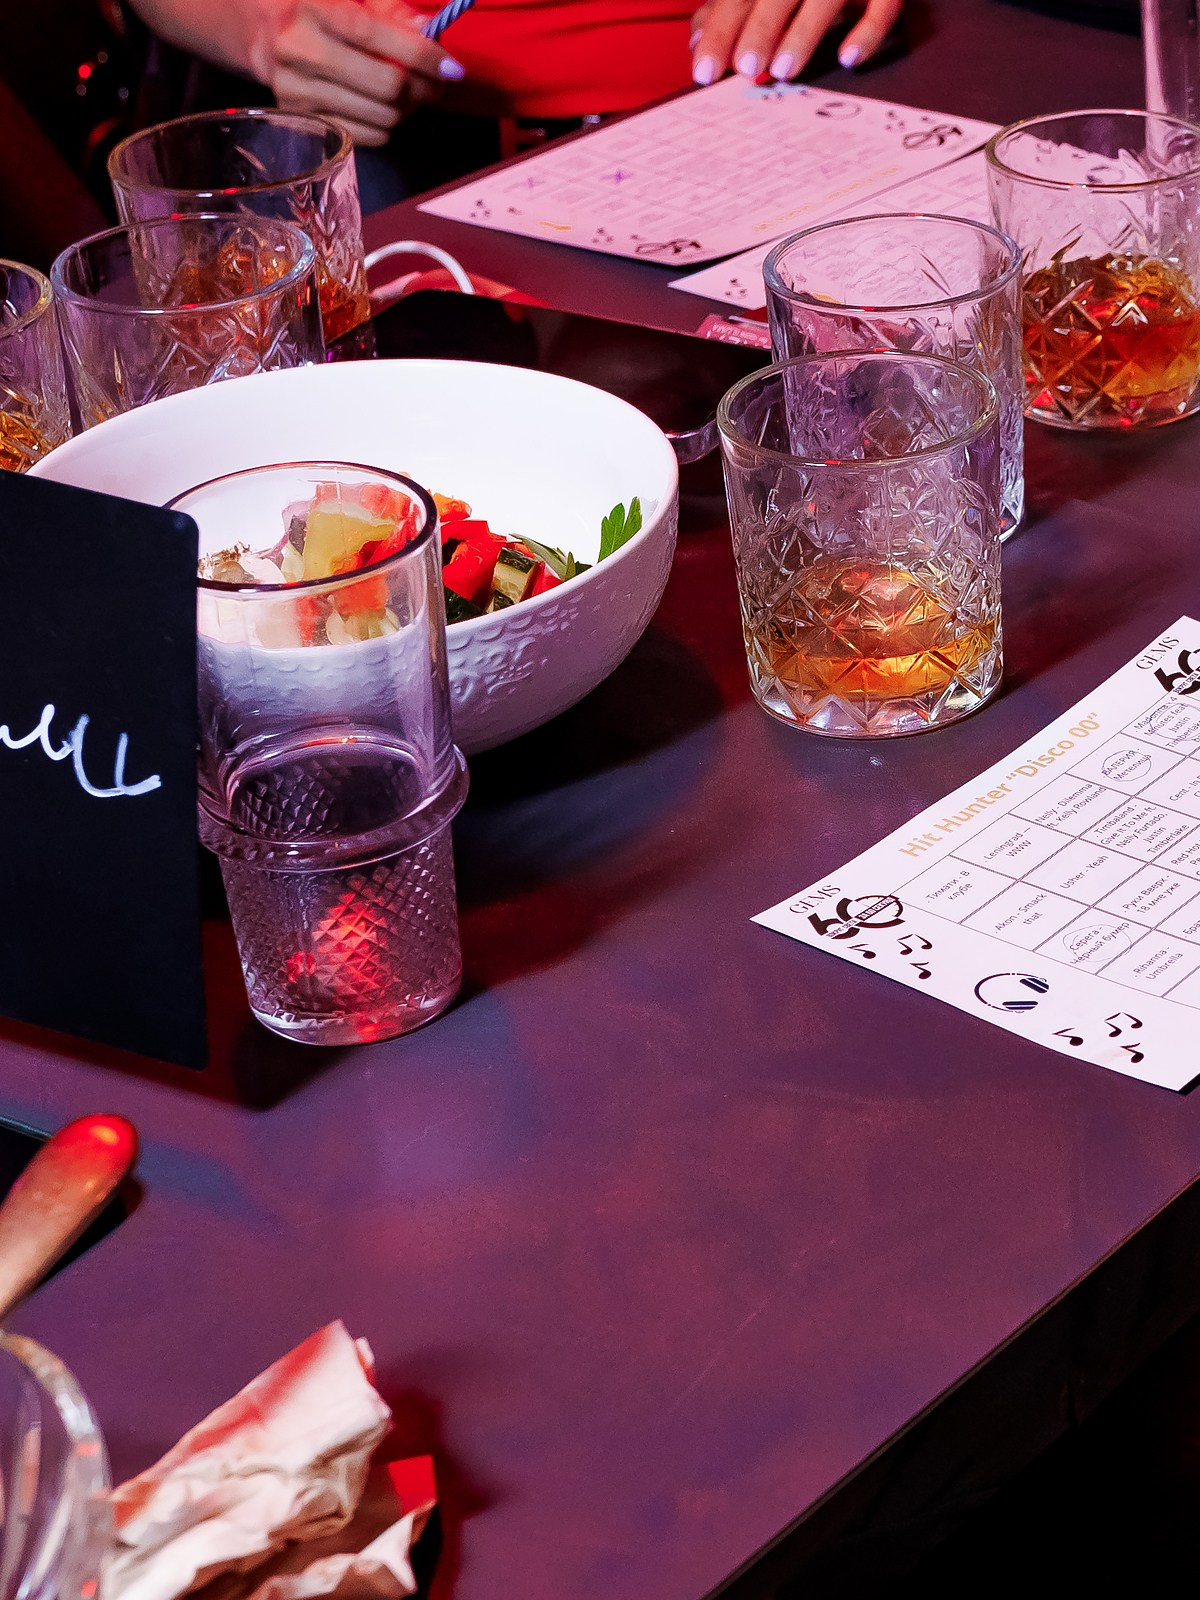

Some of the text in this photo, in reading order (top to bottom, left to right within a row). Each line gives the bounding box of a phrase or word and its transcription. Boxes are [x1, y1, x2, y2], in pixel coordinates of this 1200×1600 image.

[1135, 636, 1180, 670] GEMS
[1133, 704, 1172, 730] Madonna
[1143, 714, 1175, 737] Minutes
[1167, 716, 1191, 733] Justin
[1100, 749, 1139, 776] ВАЛЕРИЯ
[1112, 754, 1152, 781] Метелица
[897, 711, 1100, 857] Hit Hunter “Disco 00”
[1168, 788, 1190, 802] Cent
[1188, 779, 1200, 787] In
[1034, 808, 1058, 823] Nelly
[1056, 783, 1093, 807] Dilemma
[1055, 808, 1078, 822] Kelly
[1072, 786, 1107, 810] Rowland
[1093, 806, 1135, 834] Timbaland
[1099, 832, 1121, 845] Give
[1121, 820, 1136, 828] To
[1131, 811, 1149, 822] Me
[1115, 813, 1168, 848] Nelly Furtado,
[983, 832, 1024, 860] Leningrad
[1142, 826, 1167, 844] Justin
[1146, 824, 1190, 854] Timberlake
[1059, 871, 1086, 889] Usher
[1085, 855, 1109, 869] Yeah
[1170, 852, 1189, 866] Red
[788, 884, 841, 914] GEMS
[924, 878, 959, 900] Тимати
[947, 883, 973, 901] клубе
[1121, 895, 1145, 910] Руки
[1140, 877, 1165, 896] Вверх
[1136, 882, 1181, 914] 18 мне уже
[994, 915, 1018, 931] Akon
[1017, 893, 1047, 913] Smack
[1022, 911, 1043, 925] that
[1101, 922, 1130, 941] бумер
[1132, 949, 1168, 974] Rihanna
[1145, 952, 1183, 980] Umbrella
